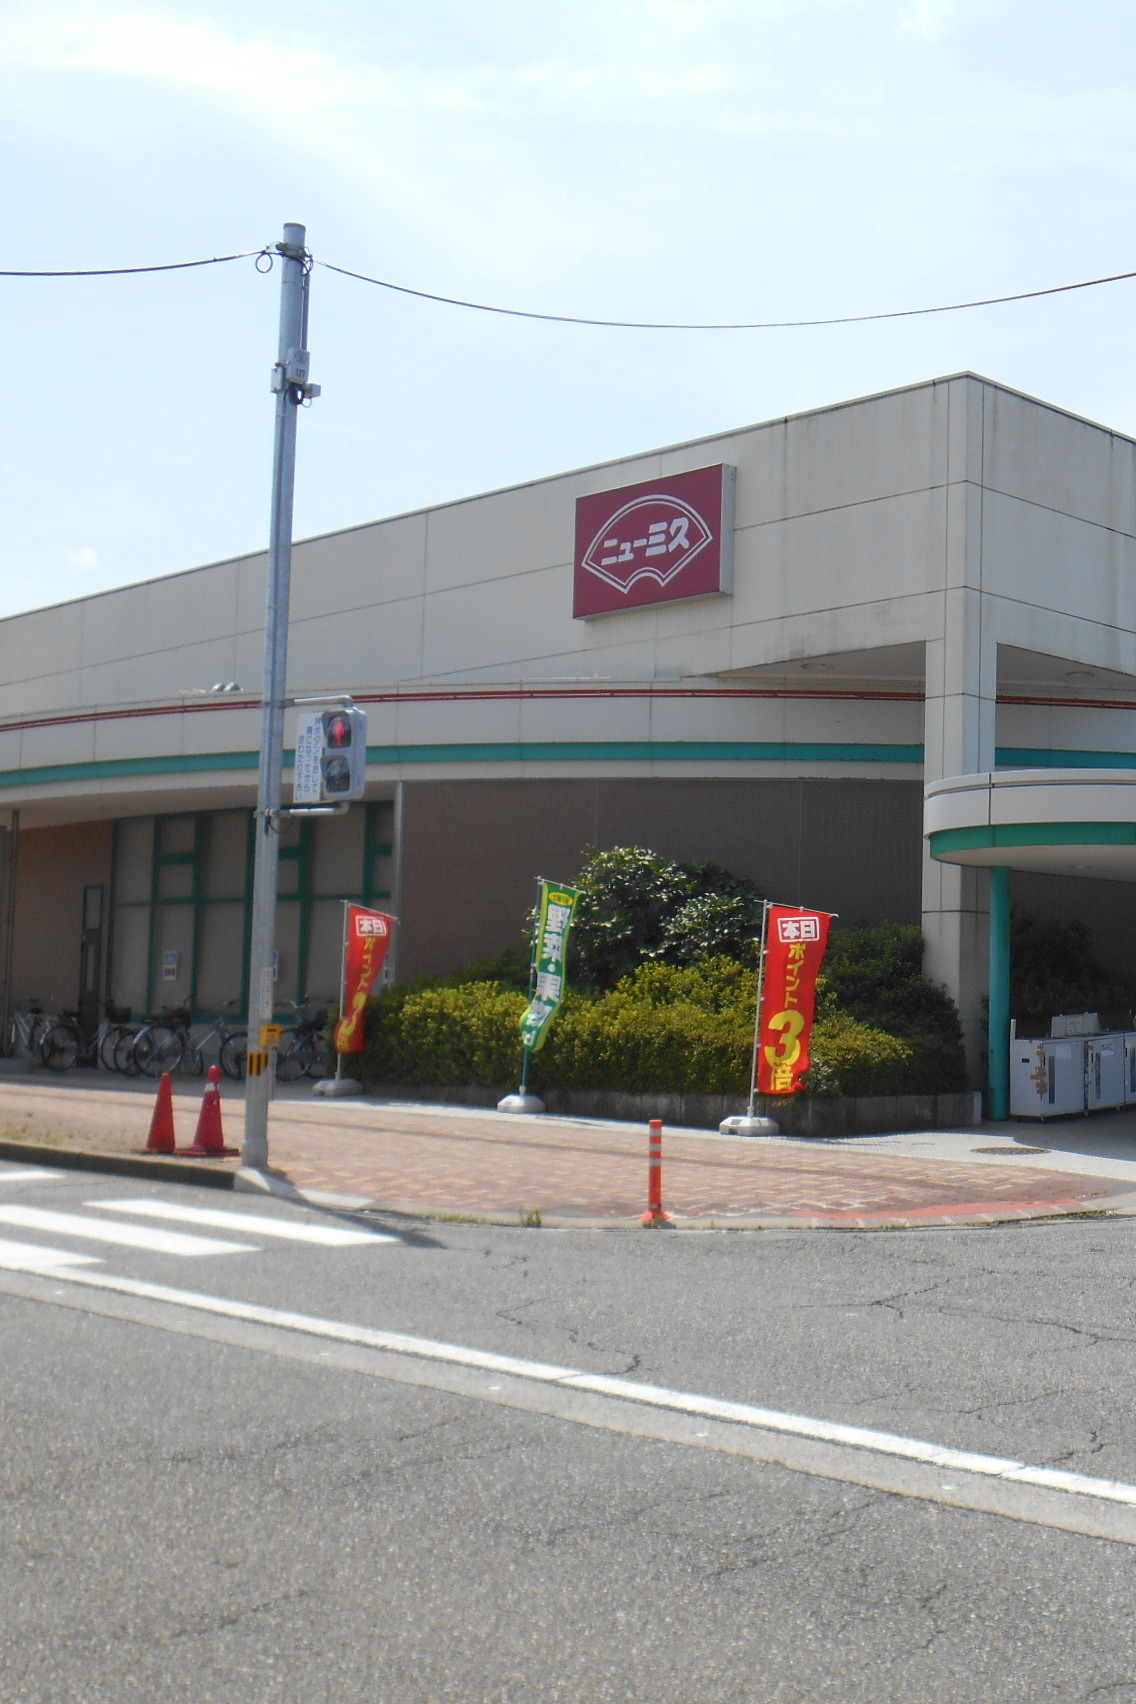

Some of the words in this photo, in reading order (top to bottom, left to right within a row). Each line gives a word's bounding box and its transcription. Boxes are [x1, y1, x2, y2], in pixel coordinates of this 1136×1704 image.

[601, 517, 690, 566] ニューミス
[359, 919, 384, 934] 本日
[782, 921, 816, 939] 本日
